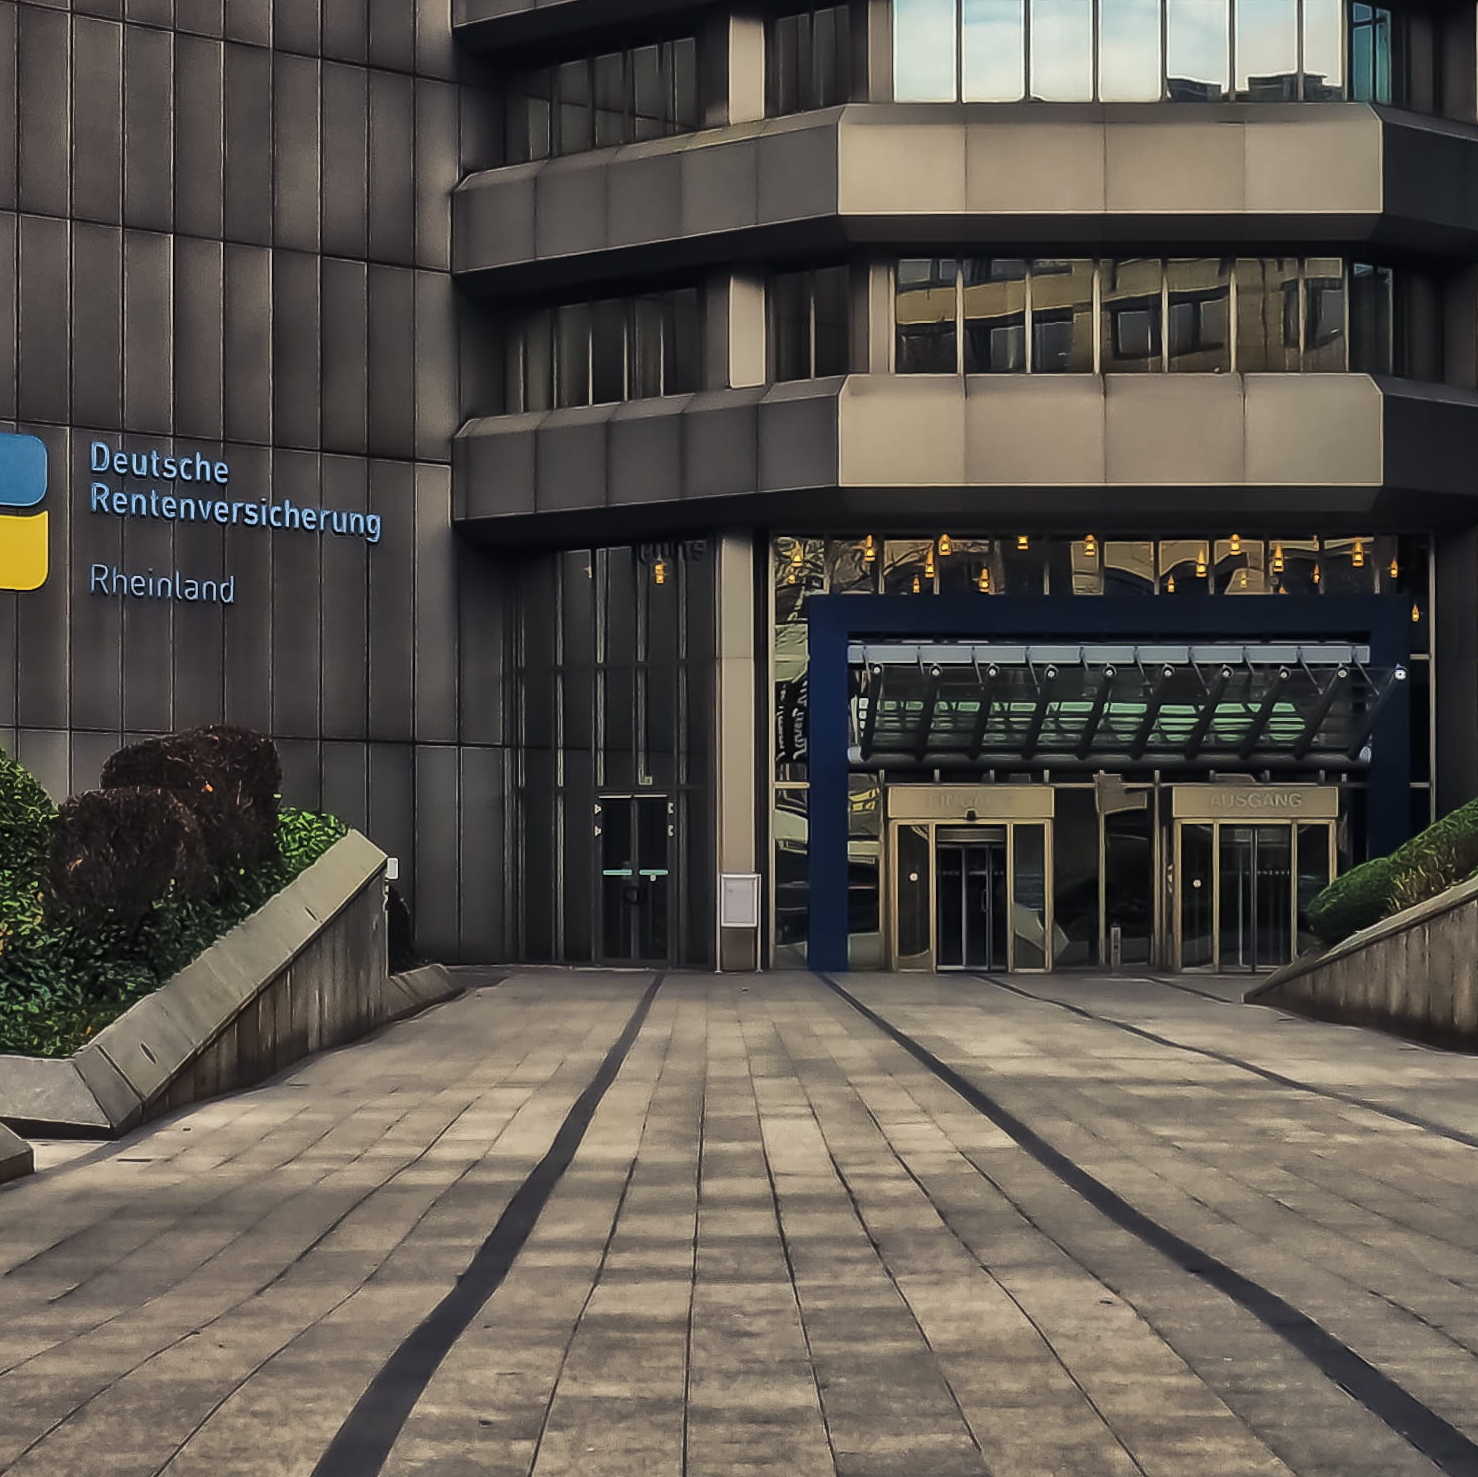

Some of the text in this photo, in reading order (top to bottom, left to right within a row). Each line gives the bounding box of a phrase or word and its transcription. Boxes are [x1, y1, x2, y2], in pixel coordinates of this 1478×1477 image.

[90, 441, 229, 484] Deutsche
[90, 481, 382, 543] Rentenversicherung
[89, 564, 236, 604] Rheinland
[1209, 793, 1303, 808] AUSGANG
